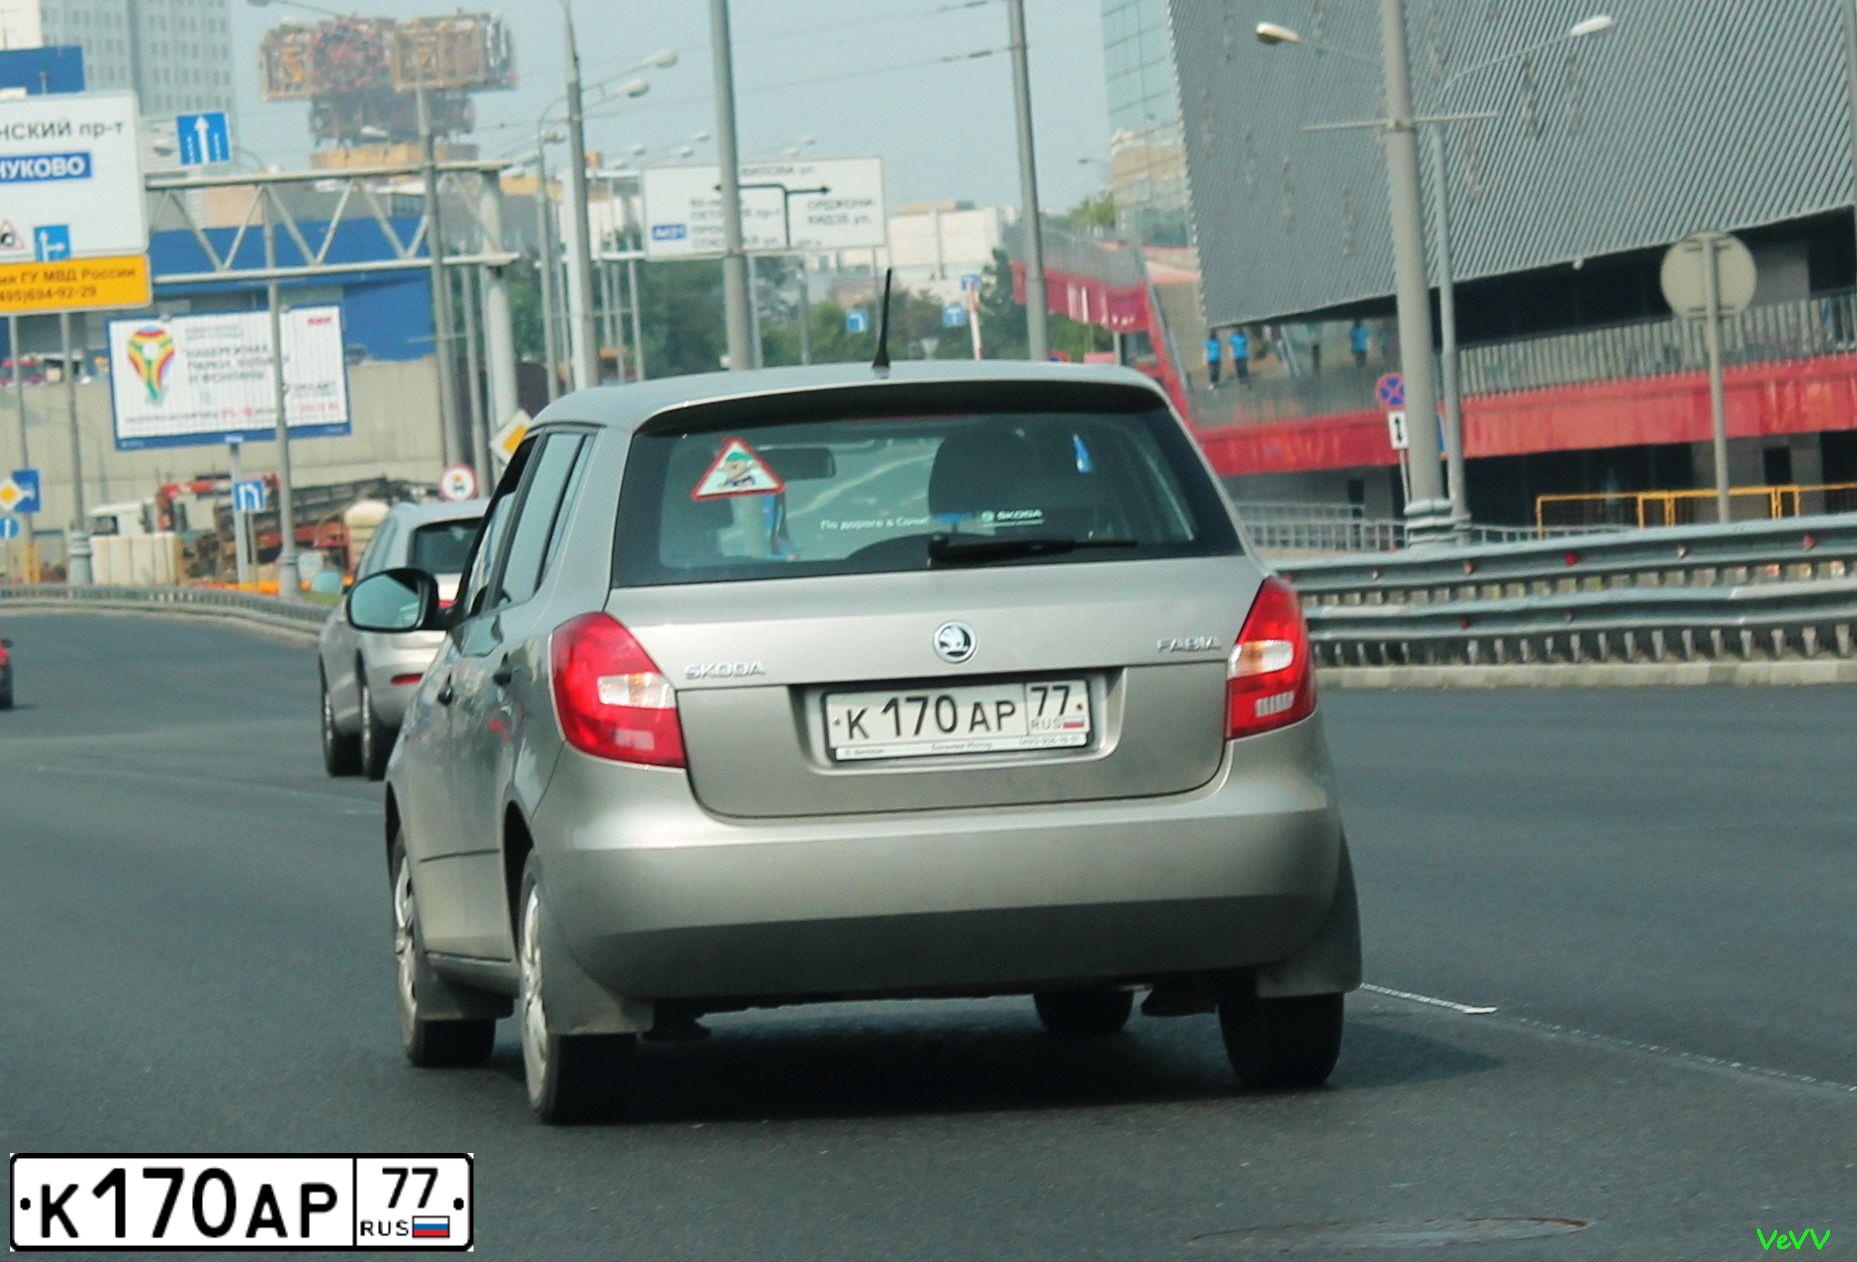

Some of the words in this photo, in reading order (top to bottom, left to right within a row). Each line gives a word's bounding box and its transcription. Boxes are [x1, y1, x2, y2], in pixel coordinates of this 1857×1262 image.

[43, 269, 77, 283] МВД
[1156, 636, 1221, 654] FABIA
[1030, 685, 1072, 717] 77
[1031, 718, 1062, 731] RUS
